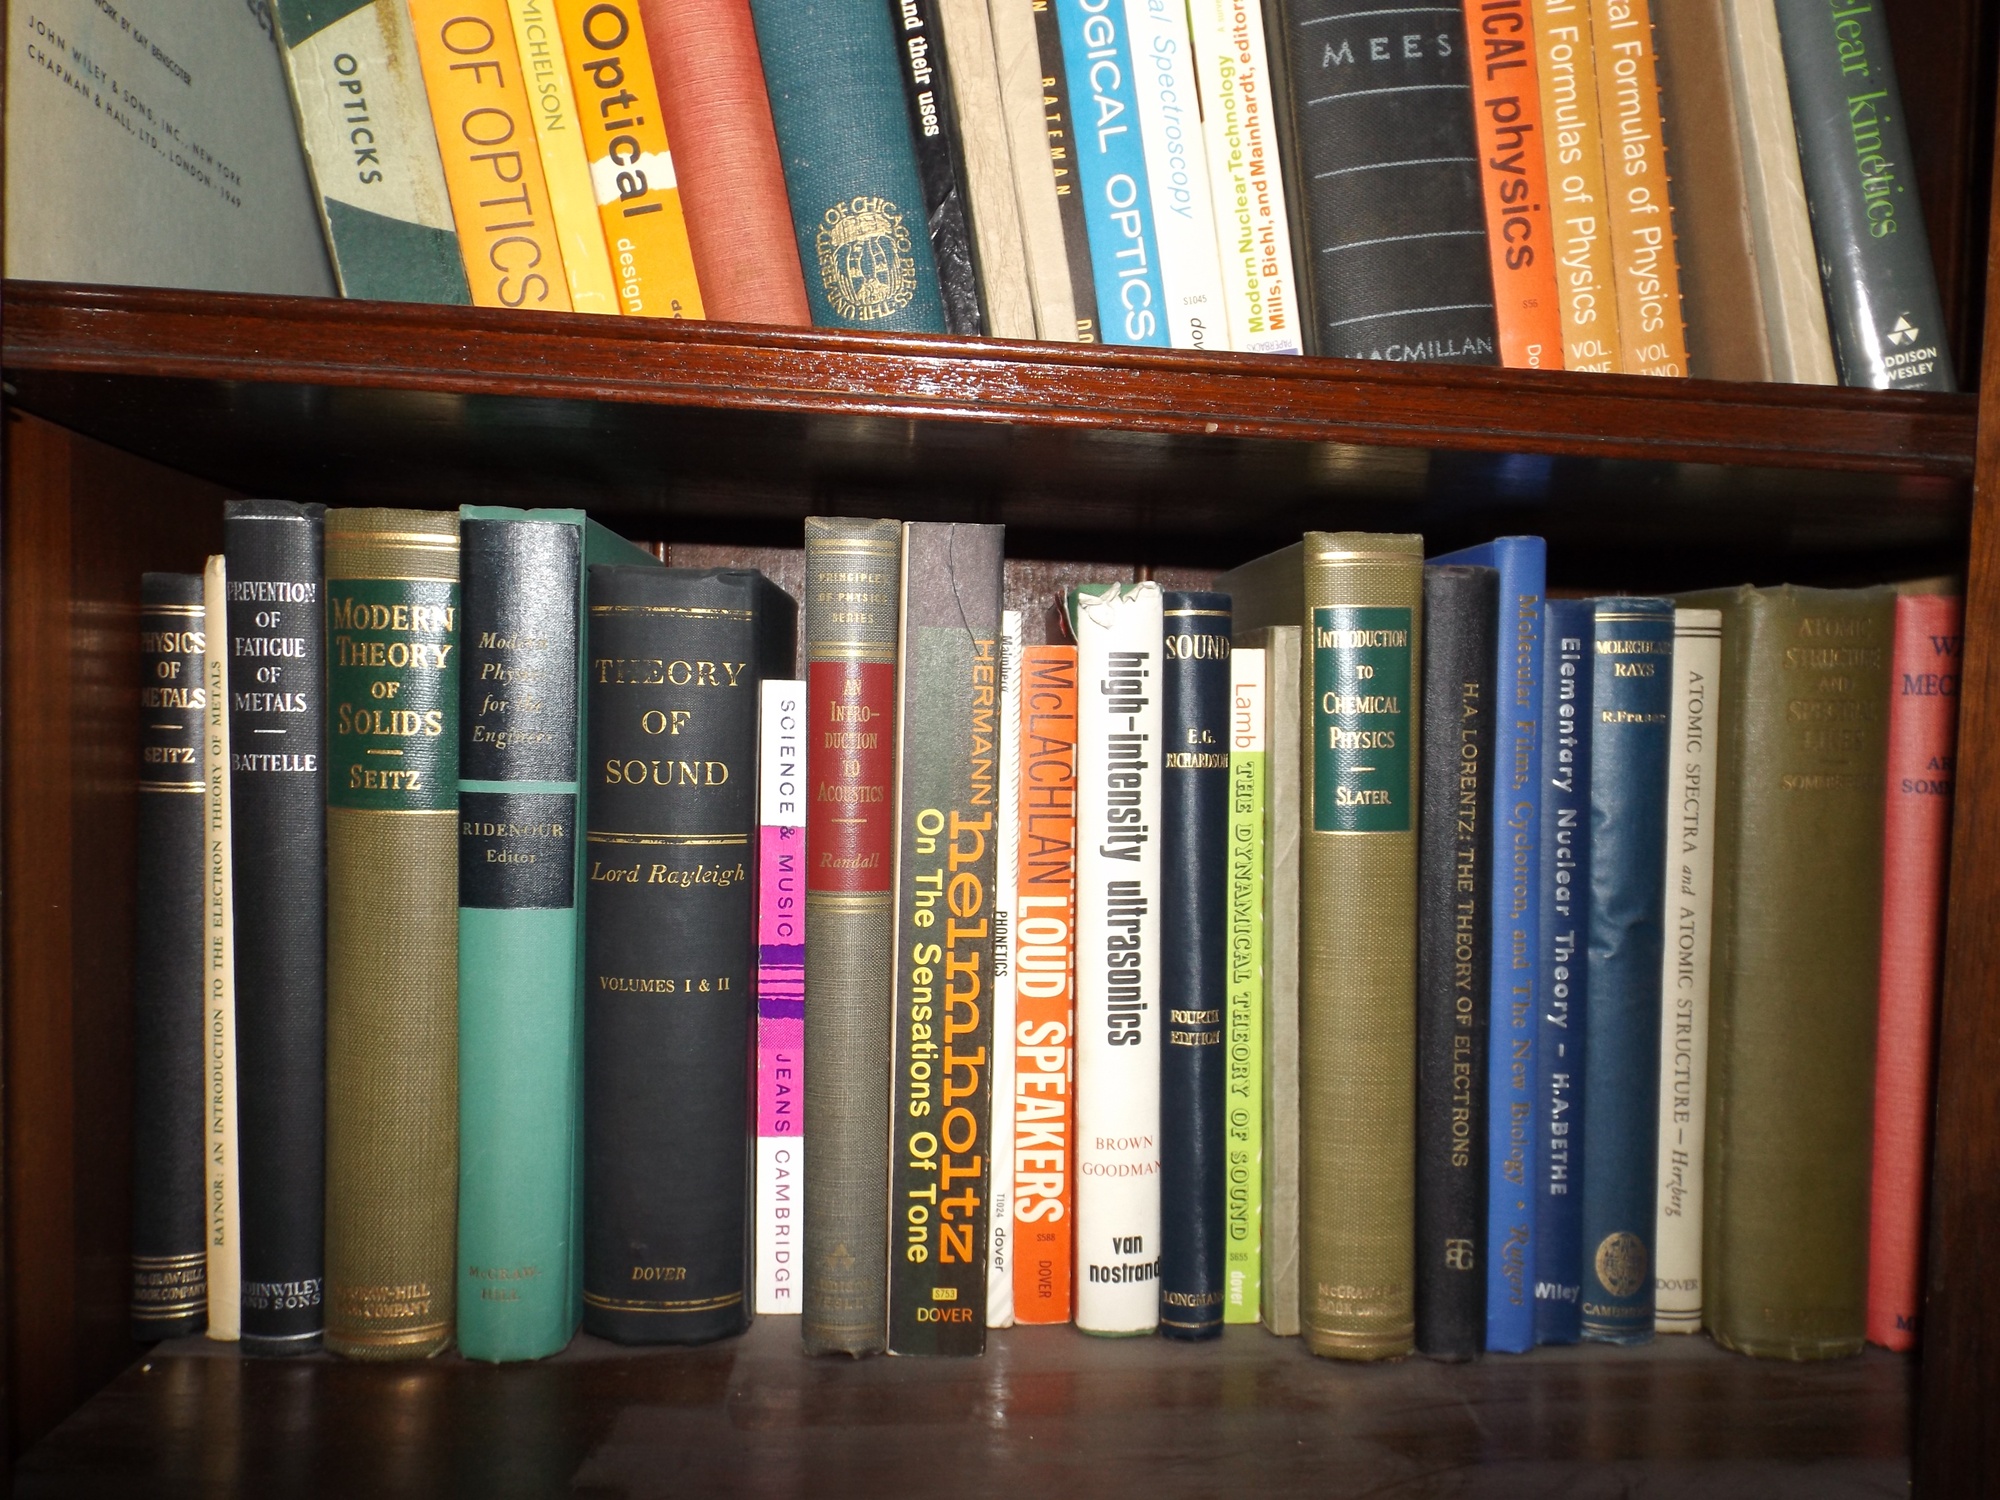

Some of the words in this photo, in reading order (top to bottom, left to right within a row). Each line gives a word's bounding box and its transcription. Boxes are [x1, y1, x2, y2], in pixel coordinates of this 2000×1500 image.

[120, 16, 131, 33] BY
[440, 15, 507, 90] OF
[518, 0, 566, 132] MICHELSON
[907, 33, 932, 86] their
[1322, 33, 1452, 68] MEES
[28, 15, 65, 51] JOHN
[72, 47, 107, 84] WILEY
[112, 80, 118, 94] &
[217, 161, 242, 187] YORK
[28, 44, 90, 99] CHAPMAN
[94, 94, 102, 109] &
[169, 150, 211, 188] LONDON
[582, 3, 663, 219] Optical
[917, 90, 940, 137] uses
[1218, 55, 1244, 173] Technology
[1548, 24, 1586, 164] Formulas
[1611, 39, 1653, 176] Formulas
[333, 52, 383, 185] OPTICKS
[1040, 75, 1071, 196] BATEMAN
[1150, 35, 1193, 219] Spectroscopy
[1239, 67, 1266, 177] Mainhardt,
[1485, 95, 1541, 271] physics
[1847, 89, 1906, 239] kinetics
[460, 106, 549, 309] OPTICS
[1252, 179, 1271, 217] and
[1562, 173, 1593, 204] of
[1628, 186, 1662, 215] of
[1233, 174, 1254, 254] Nuclear
[1105, 172, 1156, 342] OPTICS
[1258, 219, 1278, 277] Biehl,
[1561, 217, 1602, 326] Physics
[616, 237, 645, 313] design
[1245, 256, 1264, 333] Modern
[1631, 225, 1670, 333] Physics
[1267, 279, 1286, 331] Mills,
[227, 581, 316, 603] PREVENTION
[333, 598, 455, 631] MODERN
[255, 611, 281, 628] OF
[1317, 626, 1407, 648] INTRODUCTION
[157, 661, 181, 679] OF
[235, 637, 306, 658] FATIGUE
[336, 634, 453, 670] THEORY
[1165, 634, 1230, 661] SOUND
[1515, 594, 1539, 708] Molecular
[1614, 662, 1655, 677] RAYS
[211, 660, 221, 726] METALS
[256, 666, 282, 683] OF
[371, 680, 400, 699] OF
[595, 658, 748, 687] THEORY
[843, 678, 863, 697] AN
[1356, 665, 1374, 680] TO
[235, 692, 307, 713] METALS
[339, 703, 443, 738] SOLIDS
[479, 692, 510, 717] for
[641, 710, 692, 735] OF
[969, 639, 995, 806] HERMANN
[1235, 683, 1257, 750] Lamb
[1323, 692, 1401, 714] CHEMICAL
[1552, 637, 1581, 794] Elementary
[1687, 670, 1705, 754] ATOMIC
[144, 746, 196, 764] SEITZ
[212, 734, 222, 756] OF
[779, 699, 796, 815] SCIENCE
[824, 732, 878, 751] DUCTION
[1100, 651, 1149, 863] high-intensity
[1188, 728, 1216, 744] E.G.
[1330, 726, 1395, 749] PHYSICS
[1512, 719, 1537, 792] Films,
[232, 753, 317, 772] BATTELLE
[350, 765, 422, 791] SEITZ
[606, 760, 729, 787] SOUND
[844, 759, 860, 779] TO
[1028, 657, 1076, 887] McLACHLAN
[1165, 752, 1229, 769] RICHARDSON
[211, 762, 223, 831] THEORY
[817, 781, 885, 803] ACOUSTICS
[1236, 760, 1255, 814] THE
[1337, 786, 1391, 806] SLATER
[1457, 729, 1478, 841] LORENTZ:
[1682, 763, 1701, 854] SPECTRA
[462, 822, 565, 838] RIDENOUR
[780, 825, 796, 839] &
[915, 808, 945, 855] On
[486, 849, 537, 863] Editor
[591, 861, 640, 883] Lord
[647, 860, 746, 887] Rayleigh
[819, 851, 880, 870] Randall
[1457, 849, 1475, 892] THE
[1508, 801, 1533, 919] Cyclotron,
[1556, 808, 1577, 917] Nuclear
[212, 841, 223, 929] ELECTRON
[776, 855, 795, 938] MUSIC
[914, 871, 944, 929] The
[1680, 864, 1696, 897] and
[1232, 823, 1255, 988] DYNAMICAL
[212, 934, 224, 971] THE
[994, 911, 1008, 977] PHONETICS
[1016, 895, 1068, 999] LOUD
[1107, 880, 1149, 1046] ultrasonics
[1456, 900, 1474, 993] THEORY
[1512, 929, 1527, 970] and
[1676, 906, 1695, 989] ATOMIC
[212, 977, 224, 1000] TO
[600, 976, 675, 993] VOLUMES
[685, 977, 692, 993] I
[698, 977, 711, 993] &
[717, 976, 730, 992] II
[1546, 930, 1575, 1029] Theory
[1170, 1009, 1220, 1025] FOURTH
[1456, 996, 1473, 1027] OF
[1511, 979, 1533, 1028] The
[907, 941, 942, 1117] Sensations
[939, 809, 993, 1265] helmholtz
[1170, 1030, 1221, 1046] EDITION
[1231, 992, 1252, 1098] THEORY
[212, 1007, 225, 1136] INTRODUCTION
[1510, 1038, 1531, 1091] New
[1672, 999, 1693, 1124] STRUCTURE
[774, 1053, 791, 1133] JEANS
[1452, 1038, 1471, 1168] ELECTRONS
[1014, 1020, 1067, 1224] SPEAKERS
[1095, 1135, 1154, 1151] BROWN
[1230, 1108, 1251, 1141] OF
[1503, 1100, 1530, 1187] Biology
[213, 1142, 225, 1165] AN
[909, 1132, 938, 1169] Of
[997, 1194, 1005, 1218] T1024
[1229, 1150, 1249, 1241] SOUND
[1664, 1149, 1690, 1217] Herzberg
[213, 1171, 225, 1248] RAYNOR:
[774, 1149, 791, 1299] CAMBRIDGE
[905, 1181, 938, 1264] Tone
[995, 1226, 1005, 1272] dover
[1037, 1233, 1056, 1243] S588
[1112, 1234, 1143, 1254] van
[271, 1277, 322, 1297] WILEY
[632, 1266, 687, 1281] DOVER
[1038, 1259, 1052, 1299] DOVER
[1230, 1270, 1246, 1307] dover
[1502, 1223, 1529, 1307] Rutgers
[1655, 1279, 1699, 1291] DOVER
[274, 1293, 321, 1310] SONS
[917, 1306, 973, 1323] DOVER
[932, 1288, 957, 1299] S753
[1535, 1281, 1580, 1304] Wiley
